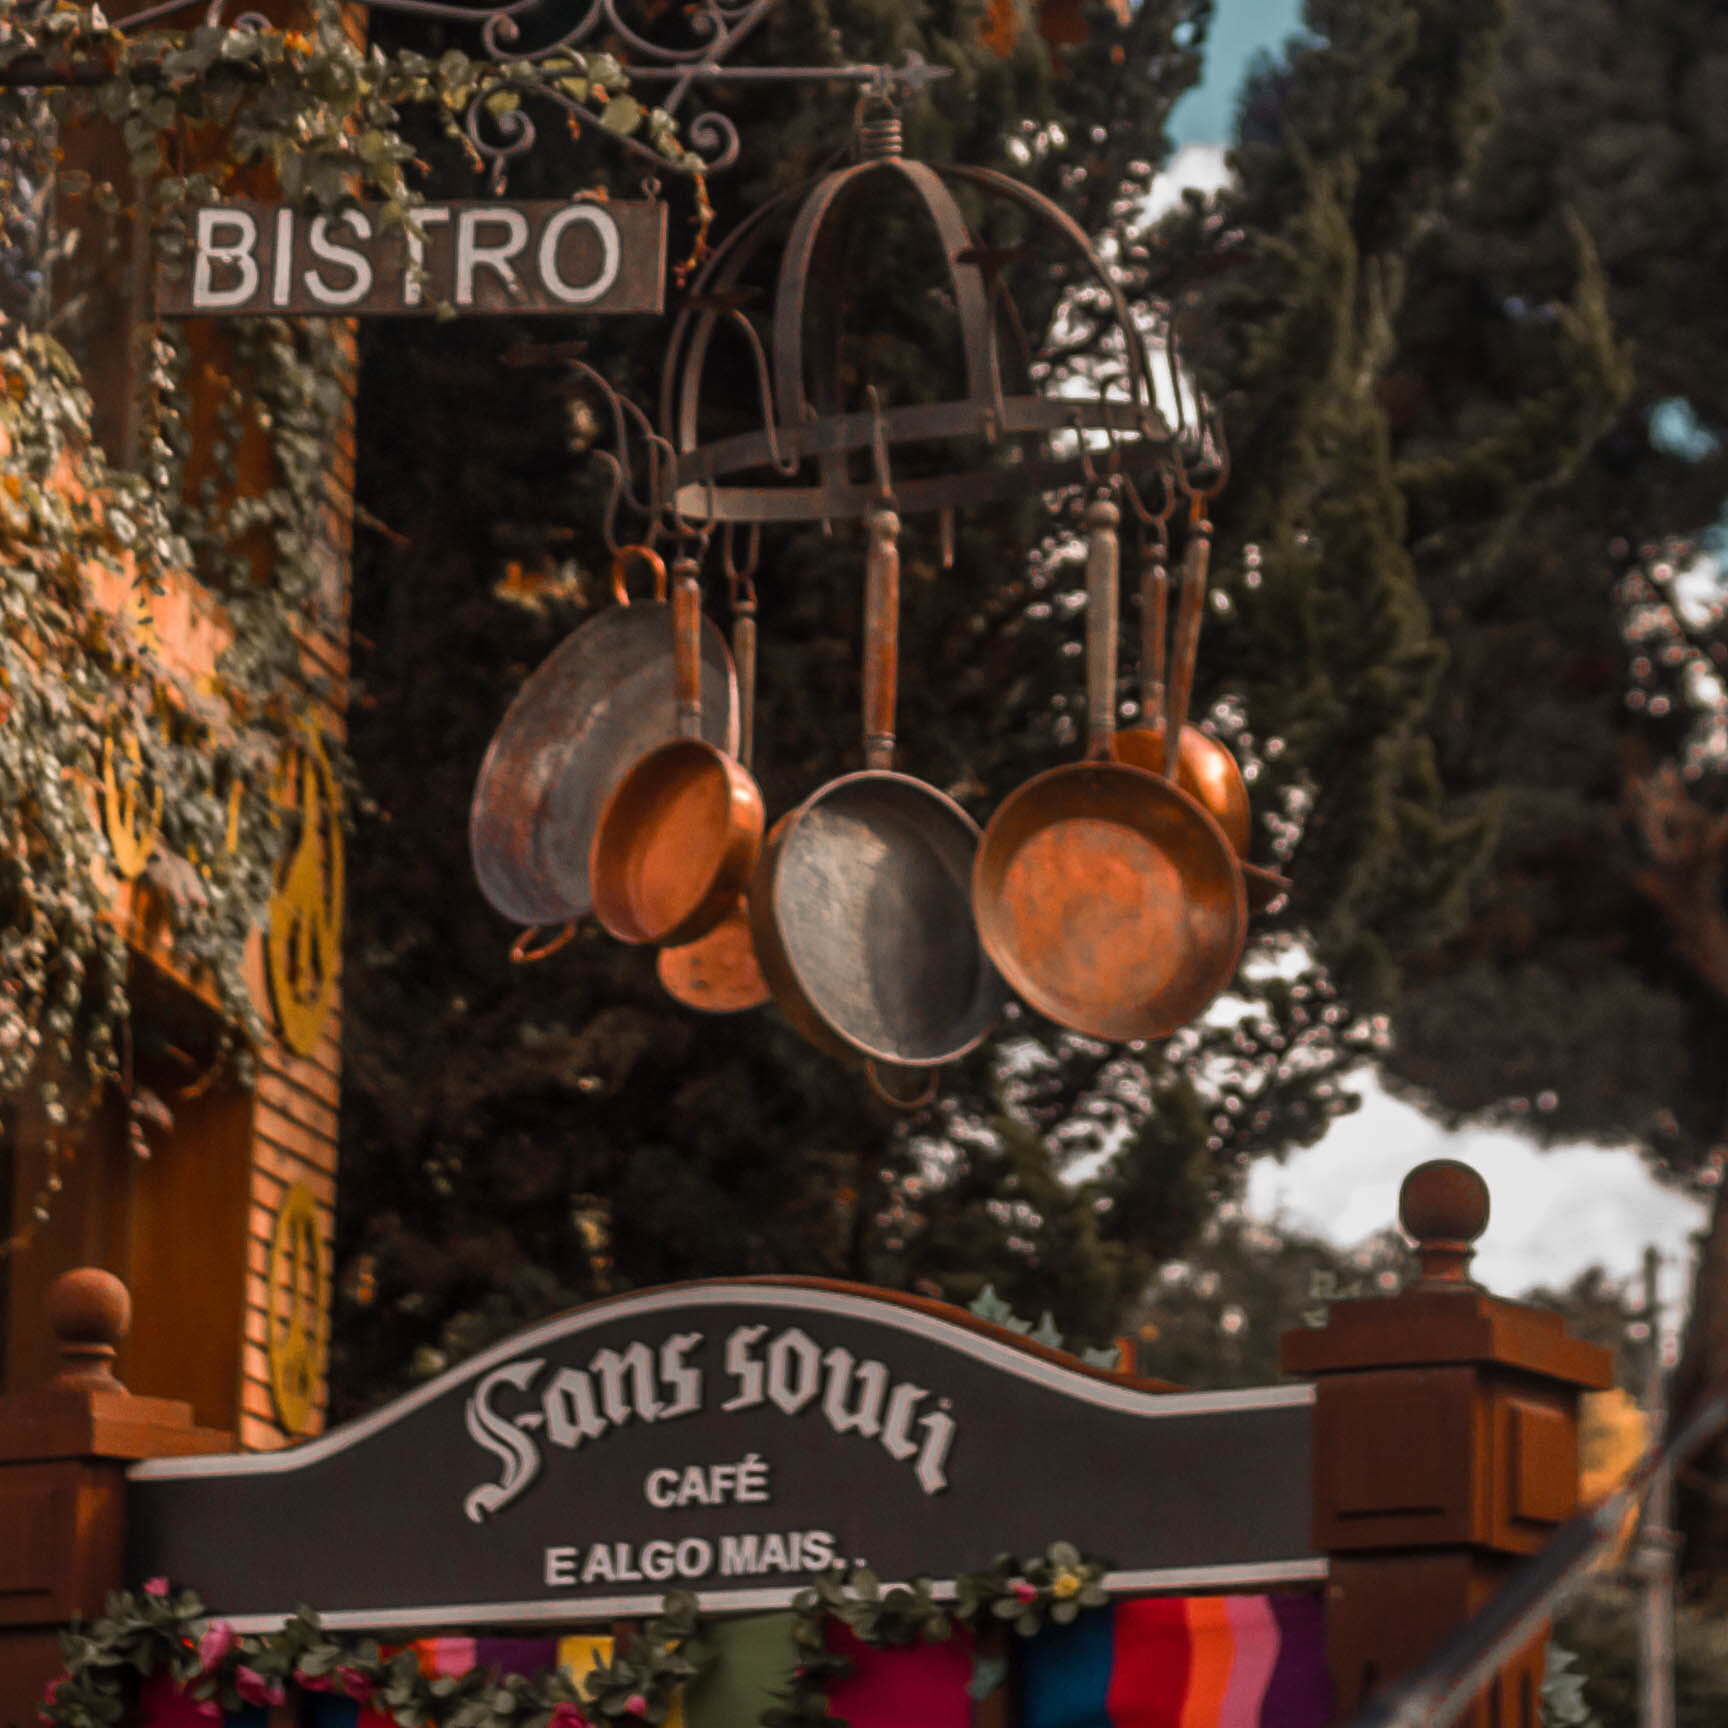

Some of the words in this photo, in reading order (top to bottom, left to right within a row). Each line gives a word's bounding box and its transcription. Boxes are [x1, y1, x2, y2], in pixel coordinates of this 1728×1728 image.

[192, 203, 621, 307] BISTRO
[465, 1332, 704, 1522] Sans
[644, 1452, 770, 1508] CAFÉ
[544, 1546, 580, 1586] E
[581, 1537, 713, 1583] ALGO
